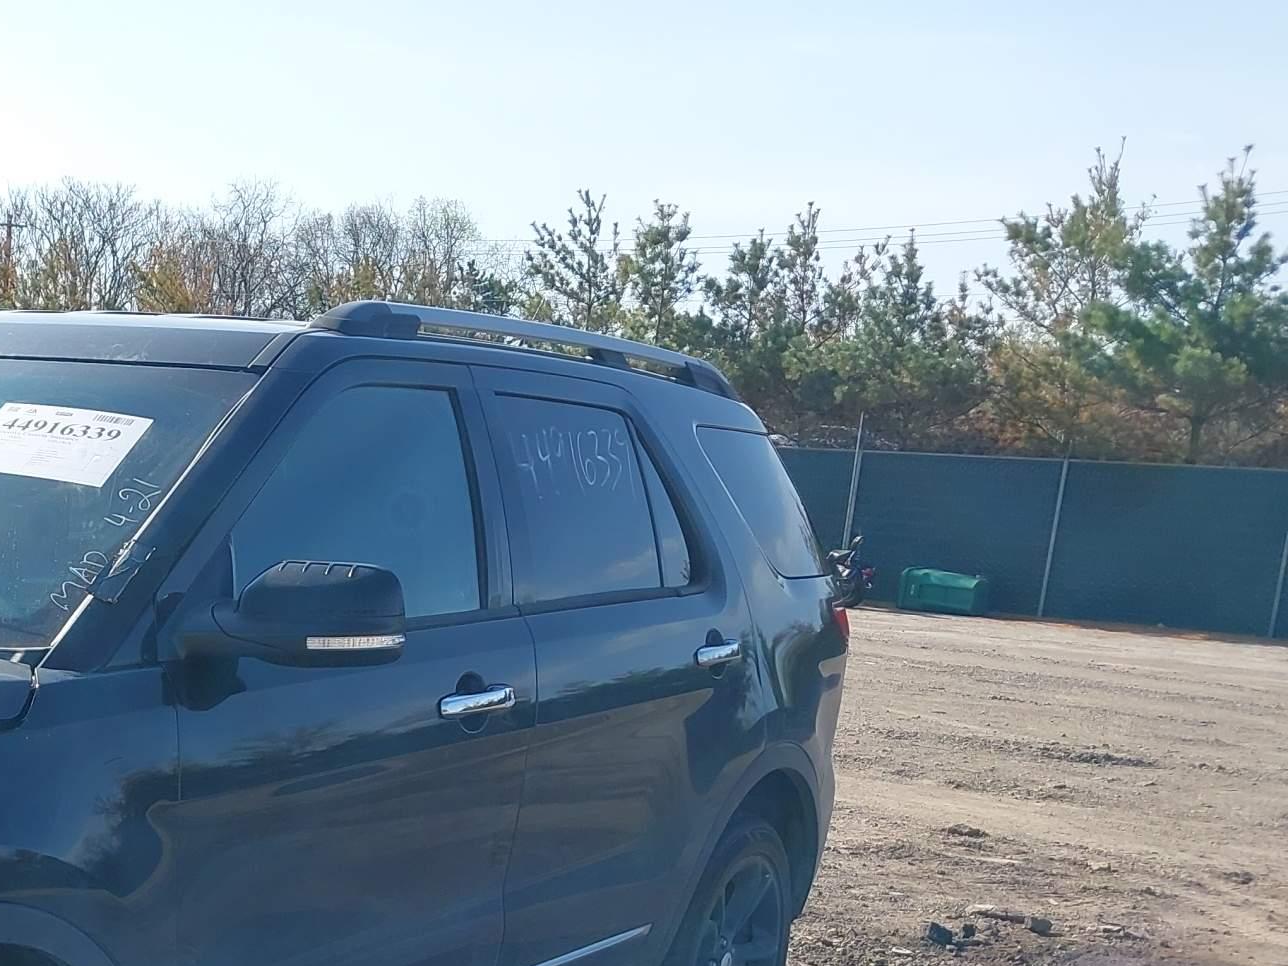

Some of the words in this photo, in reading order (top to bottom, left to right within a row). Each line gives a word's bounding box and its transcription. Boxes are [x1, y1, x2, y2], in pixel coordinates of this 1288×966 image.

[2, 417, 122, 442] 44916339
[49, 551, 110, 611] MAD
[103, 477, 162, 527] 4-21
